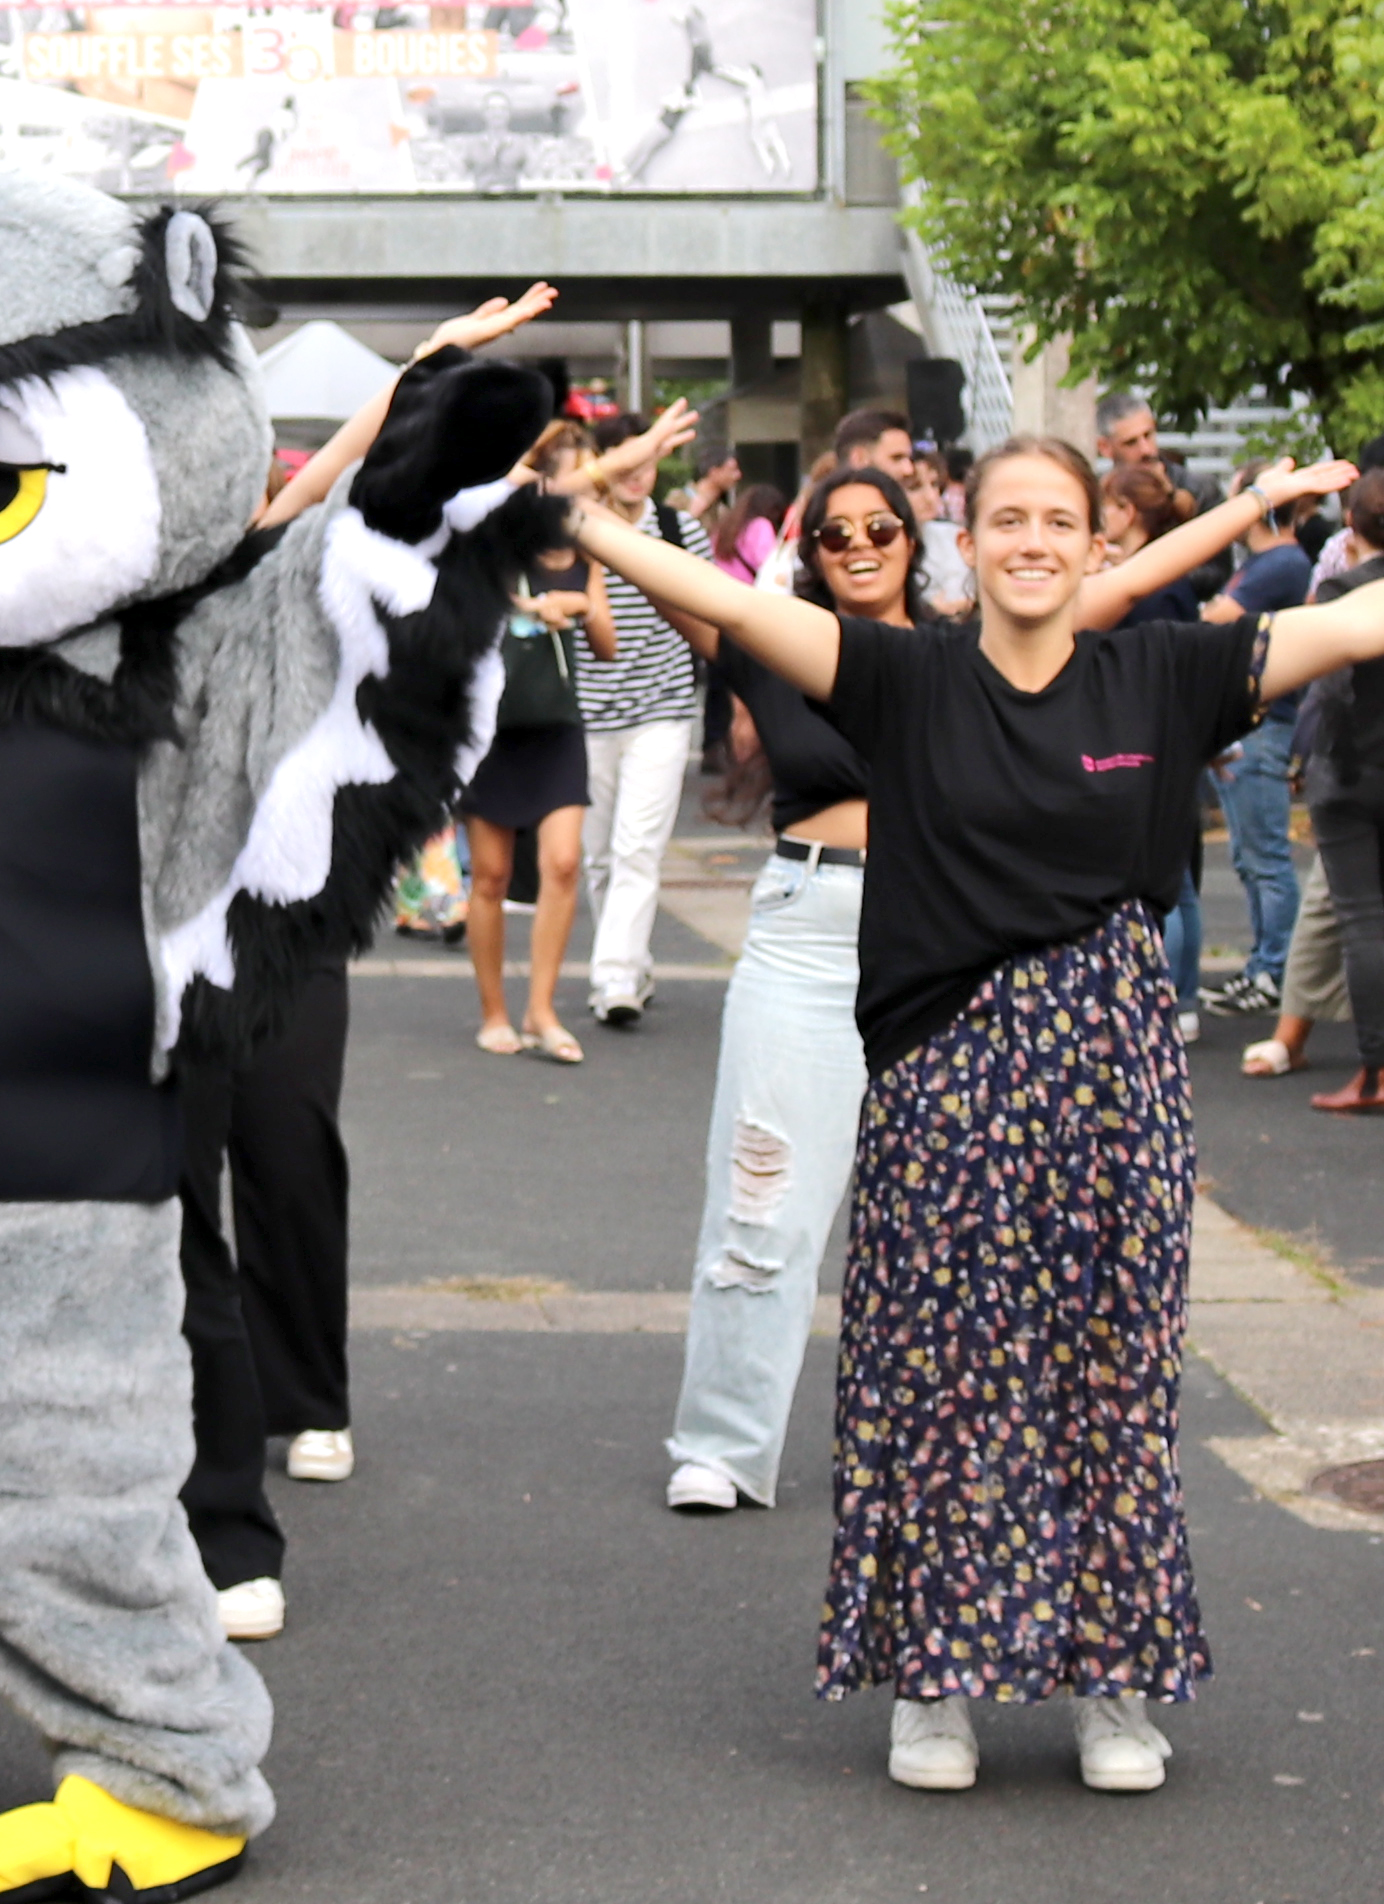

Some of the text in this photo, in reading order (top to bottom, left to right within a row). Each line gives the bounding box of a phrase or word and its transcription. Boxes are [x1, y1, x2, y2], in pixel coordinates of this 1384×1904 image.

[27, 35, 165, 77] SOUFFLE
[171, 35, 233, 76] SES
[354, 33, 489, 75] BOUGIES
